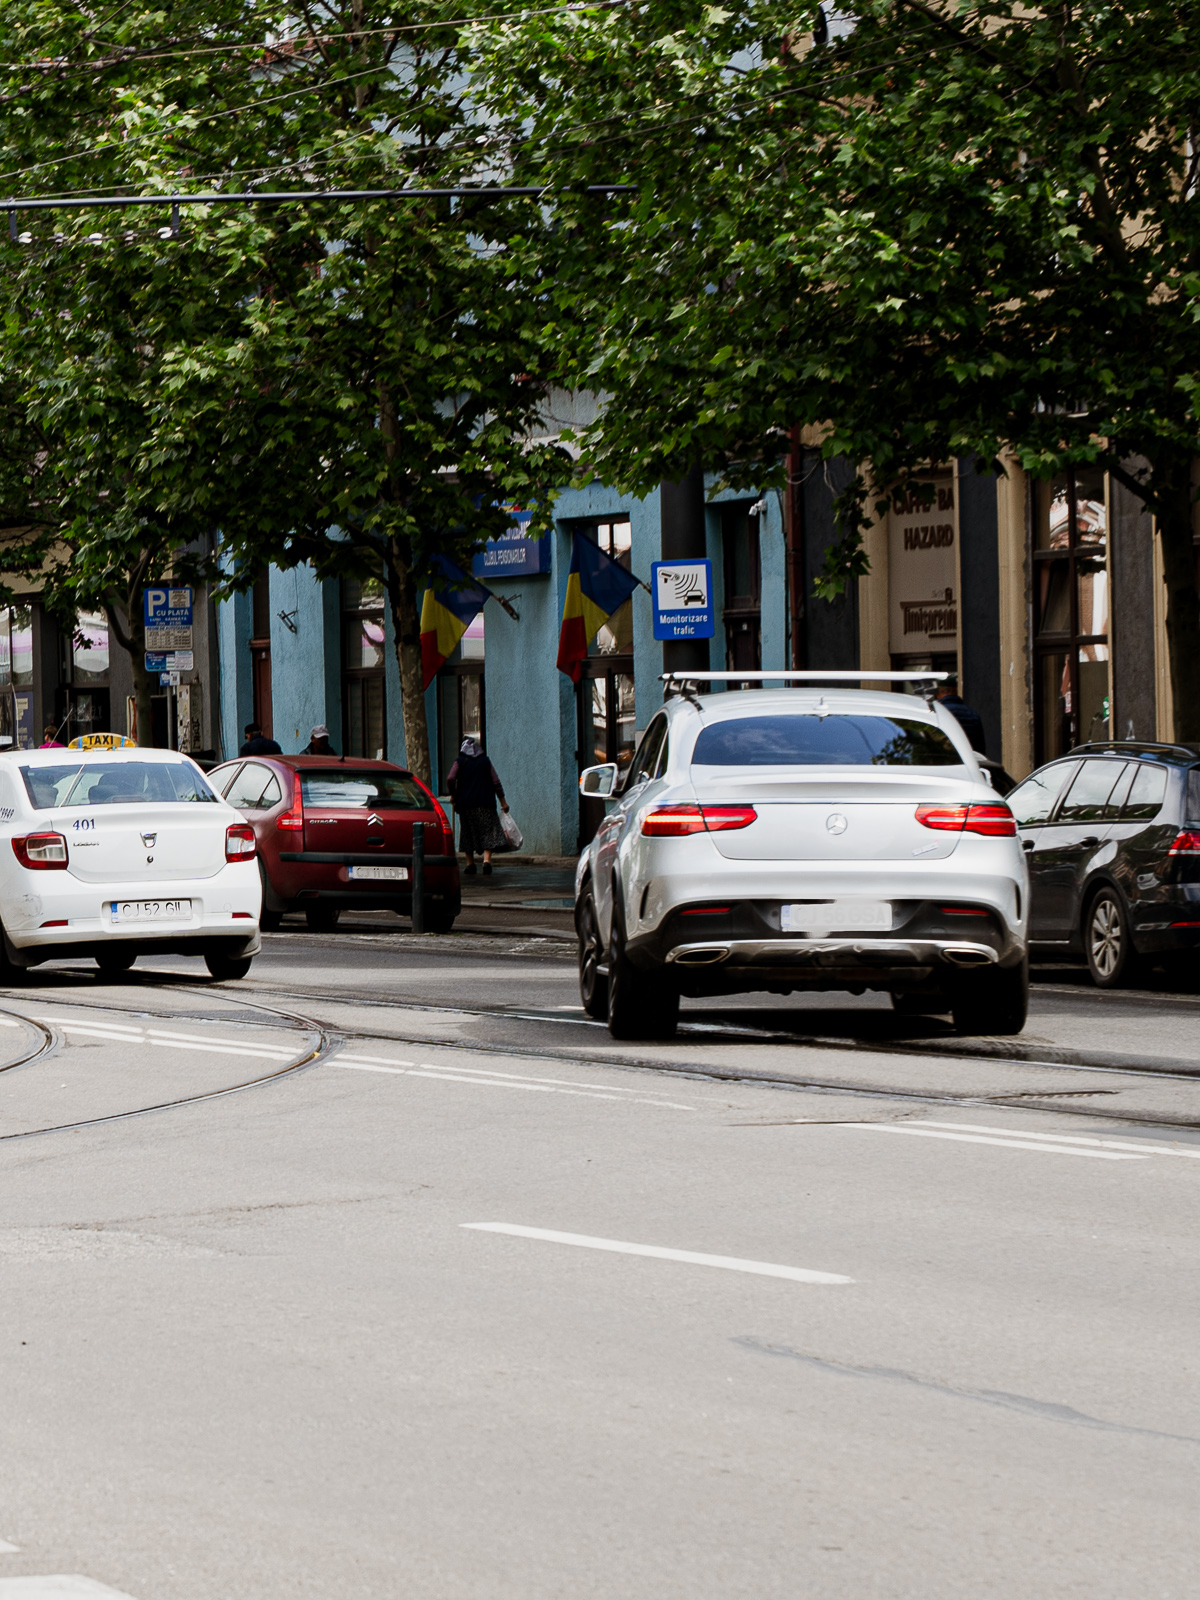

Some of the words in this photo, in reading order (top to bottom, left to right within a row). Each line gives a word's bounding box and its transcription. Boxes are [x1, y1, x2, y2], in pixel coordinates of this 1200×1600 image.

[904, 524, 954, 550] HAZARD
[148, 590, 166, 616] P
[659, 613, 708, 625] Monitorizare
[673, 625, 695, 635] trafic
[88, 735, 114, 745] TAXI
[73, 818, 96, 831] 401
[122, 904, 140, 917] CJ
[144, 903, 160, 916] 52
